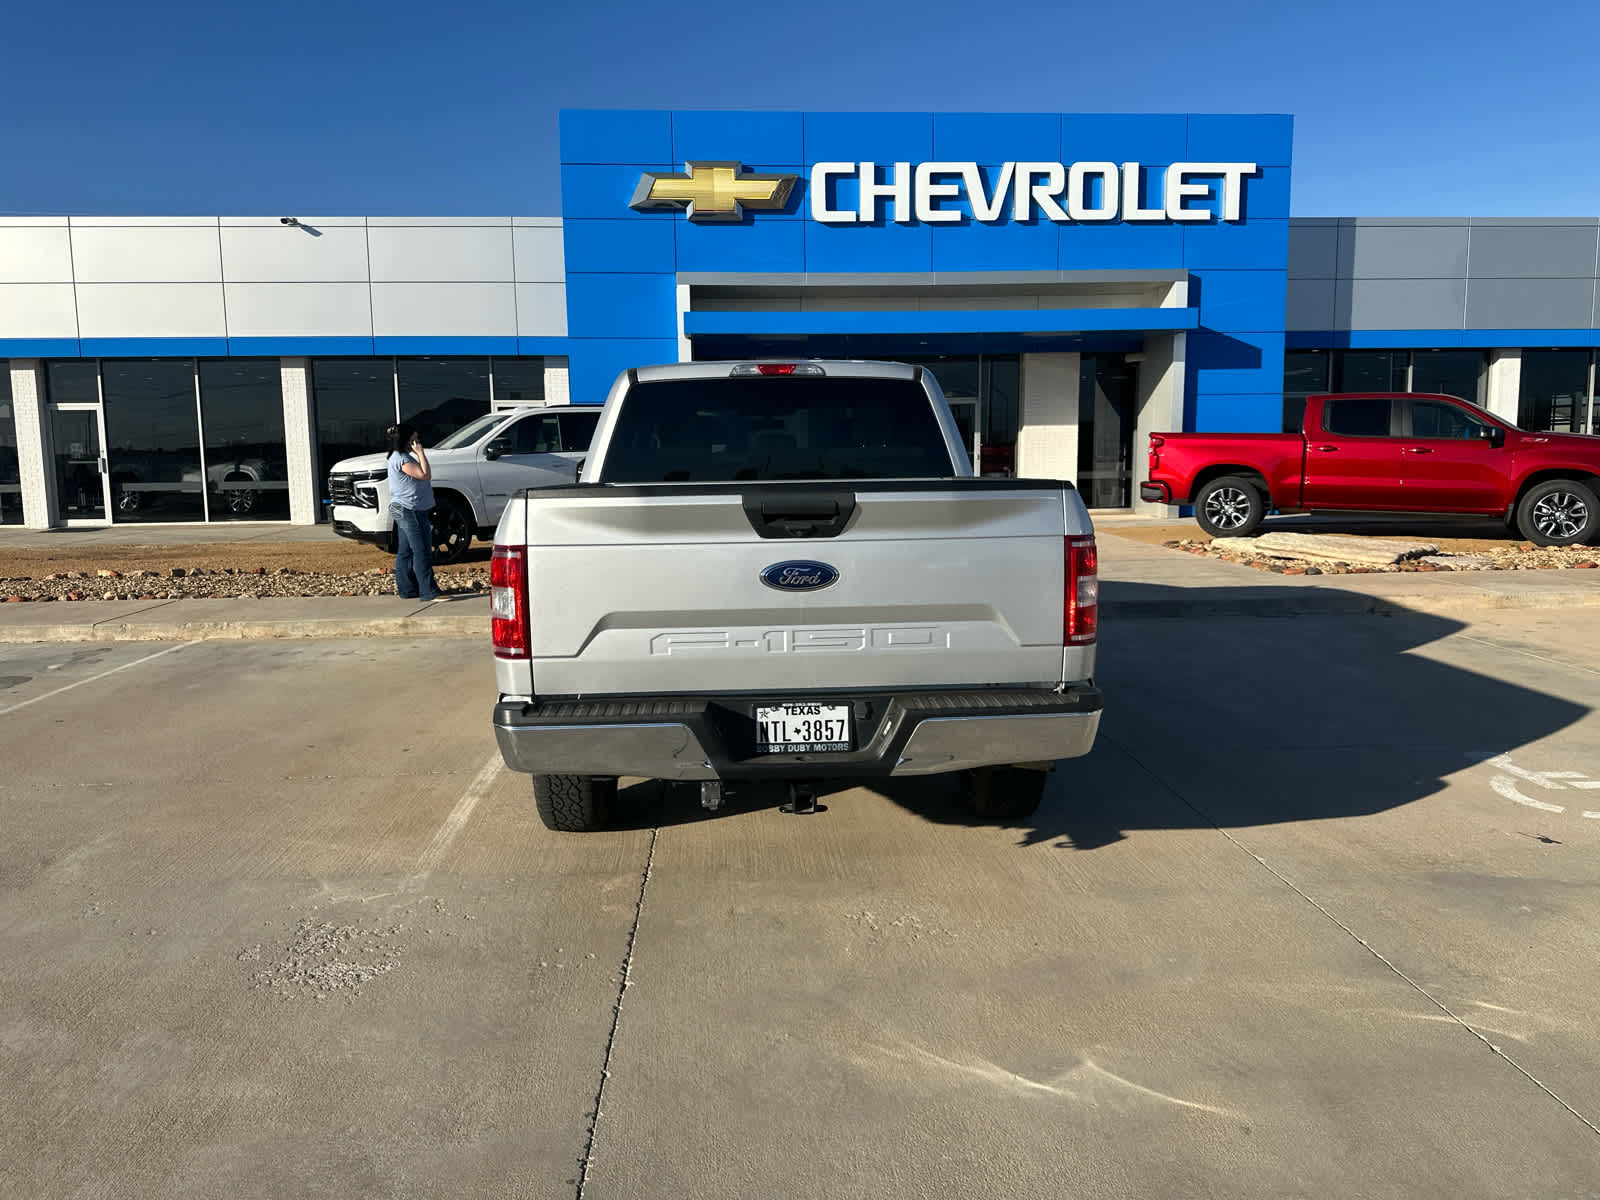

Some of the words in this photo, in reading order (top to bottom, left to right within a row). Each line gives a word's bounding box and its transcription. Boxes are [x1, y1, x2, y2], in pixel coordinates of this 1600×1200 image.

[810, 161, 1257, 222] CHEVROLET
[779, 567, 821, 585] Ford
[650, 626, 950, 656] F-150
[784, 706, 820, 716] TEXAS
[760, 721, 791, 742] NTL
[802, 720, 845, 741] 3857
[787, 744, 811, 752] DUBY
[813, 743, 849, 752] MOTORS
